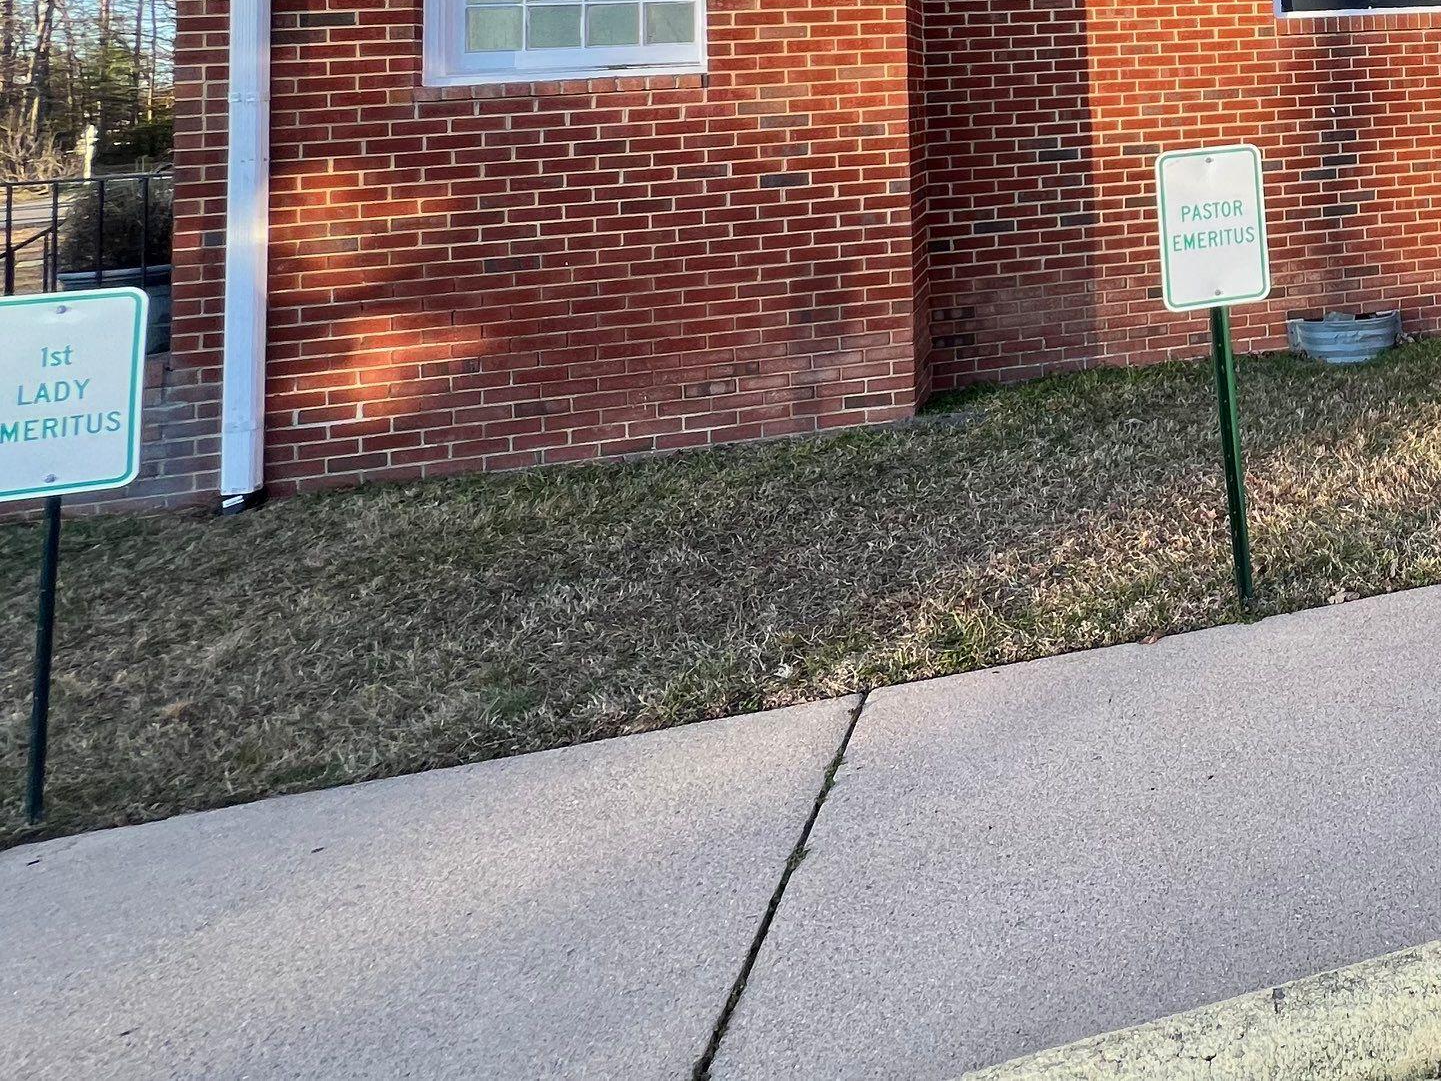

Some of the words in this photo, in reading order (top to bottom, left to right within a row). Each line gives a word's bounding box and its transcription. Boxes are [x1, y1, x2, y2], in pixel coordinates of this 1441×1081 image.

[1181, 200, 1243, 222] PASTOR
[1173, 226, 1255, 252] EMERITUS
[41, 345, 73, 367] 1st
[17, 379, 90, 406] LADY
[0, 411, 121, 444] MERITUS
